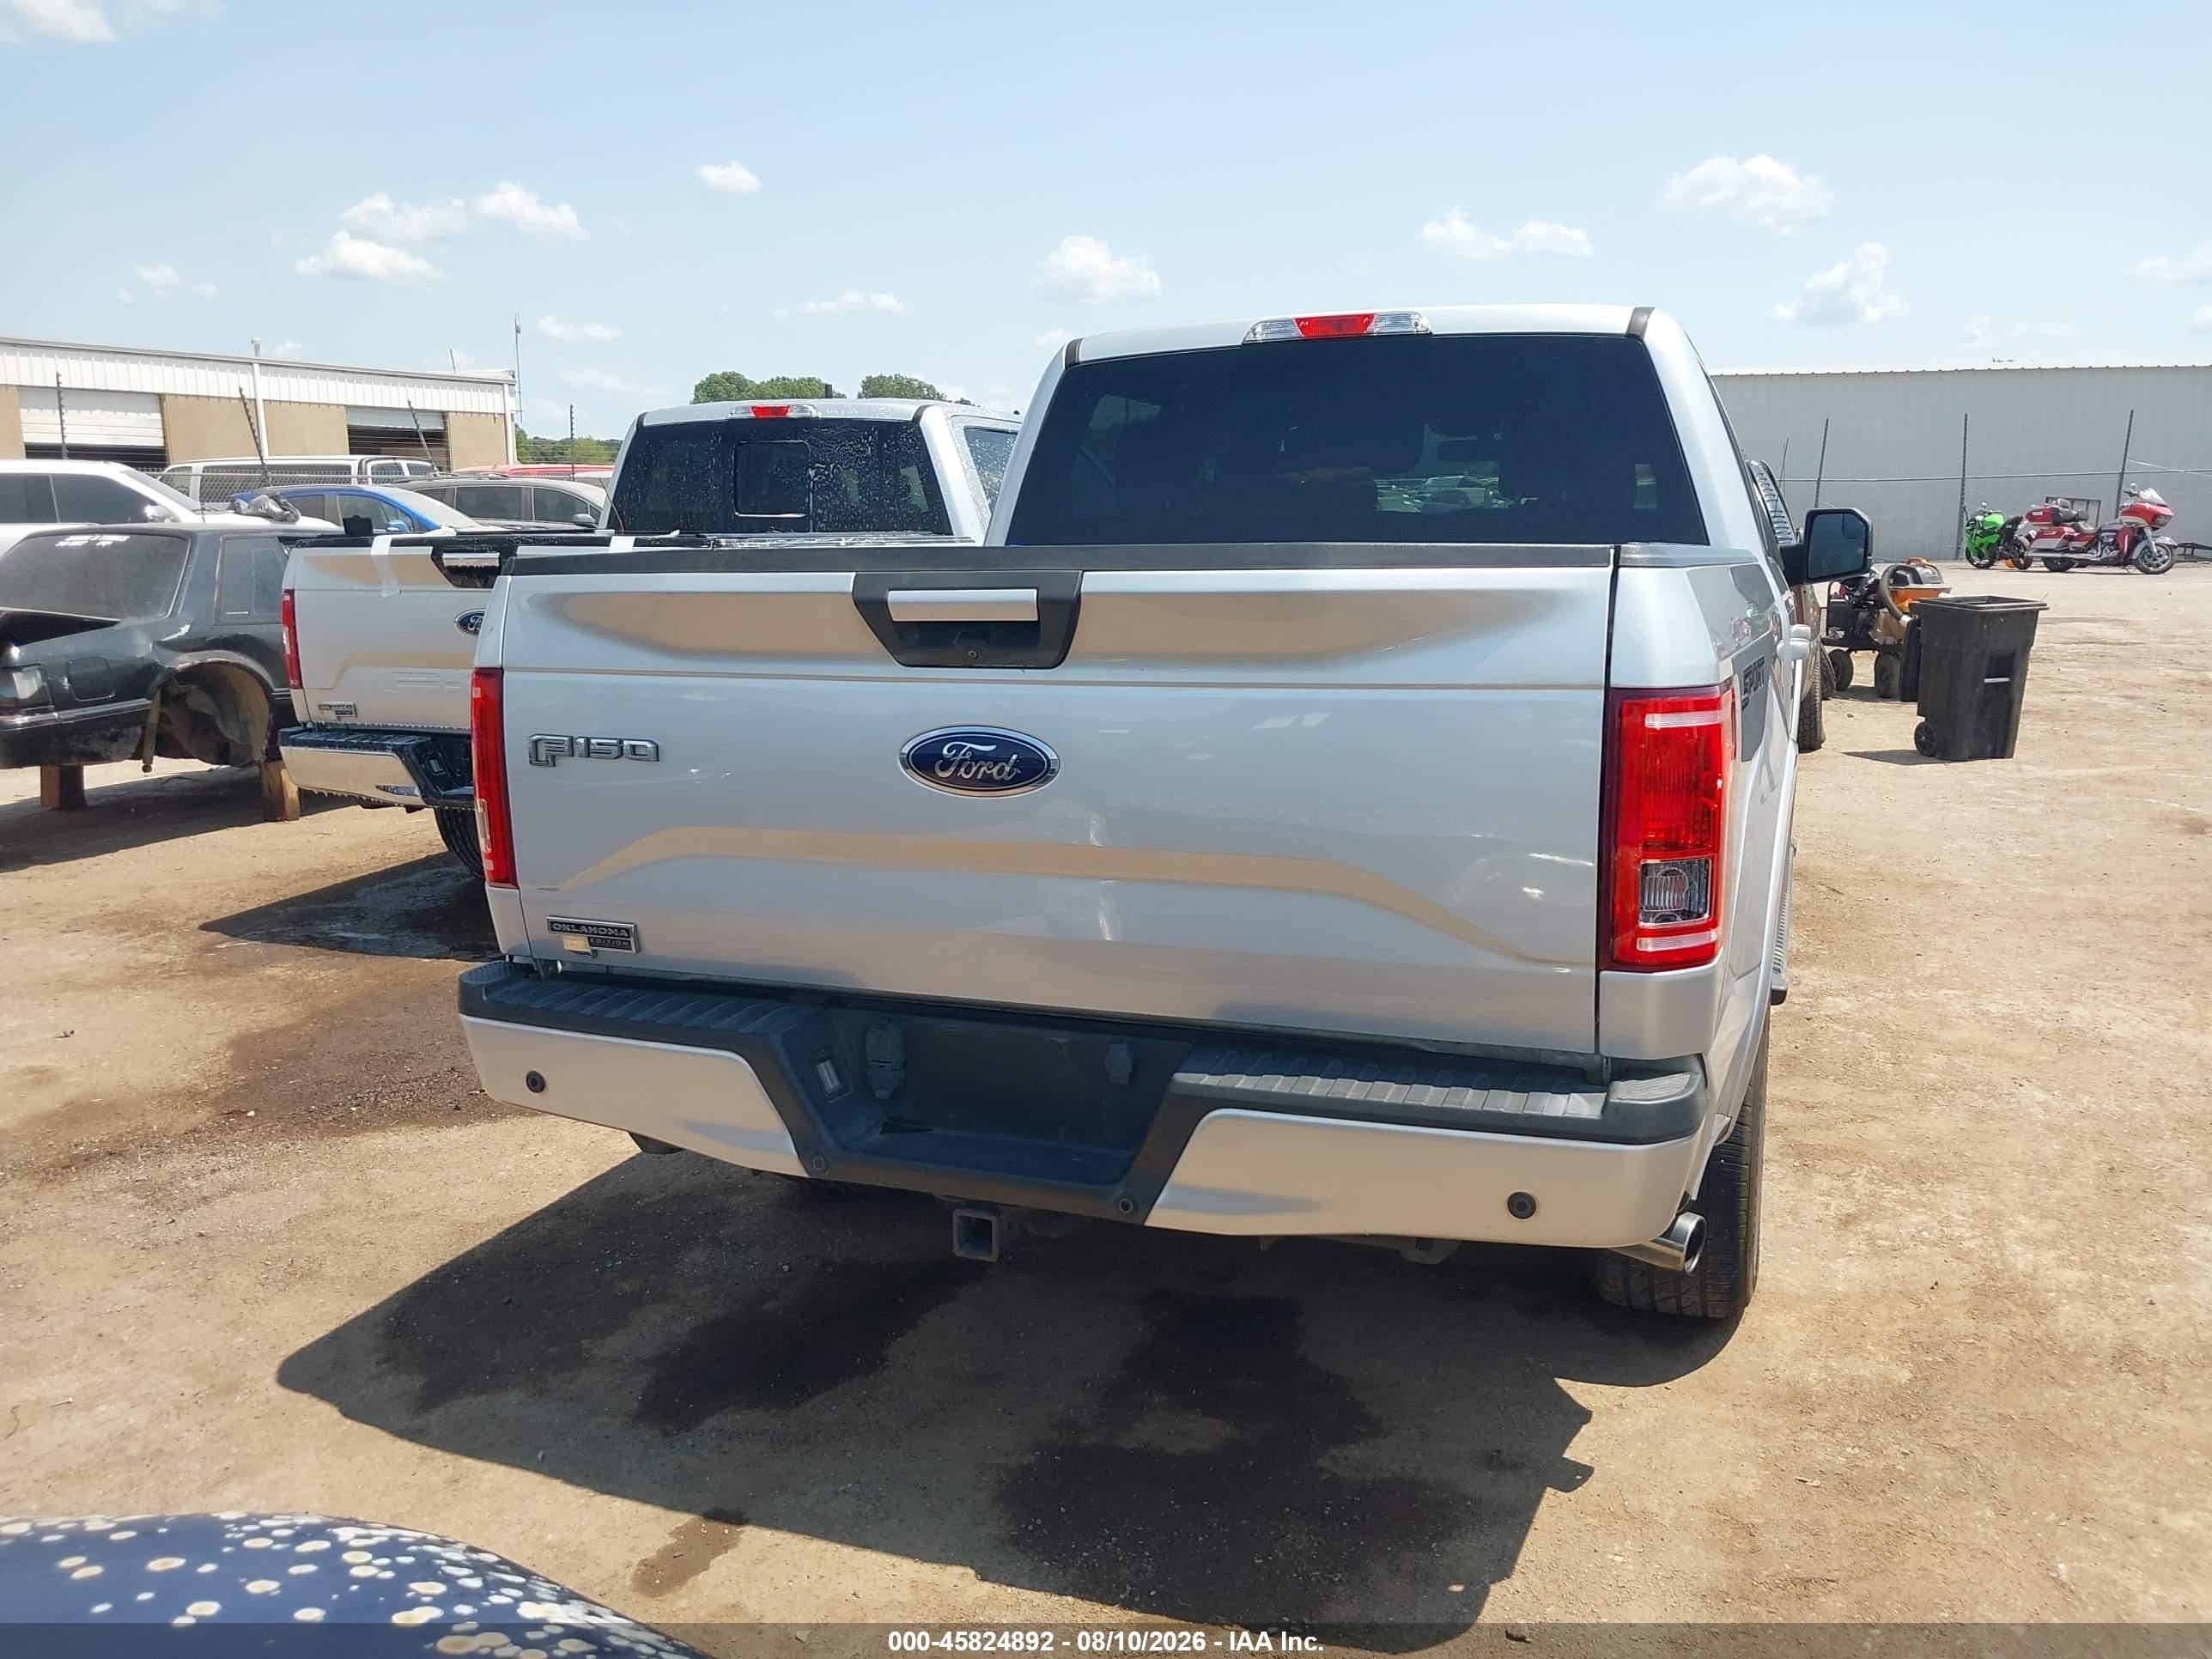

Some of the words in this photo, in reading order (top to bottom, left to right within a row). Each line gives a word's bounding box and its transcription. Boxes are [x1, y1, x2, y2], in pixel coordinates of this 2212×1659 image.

[934, 741, 1021, 781] Ford
[552, 922, 629, 937] OKLAHOMA
[590, 938, 629, 946] EDITION
